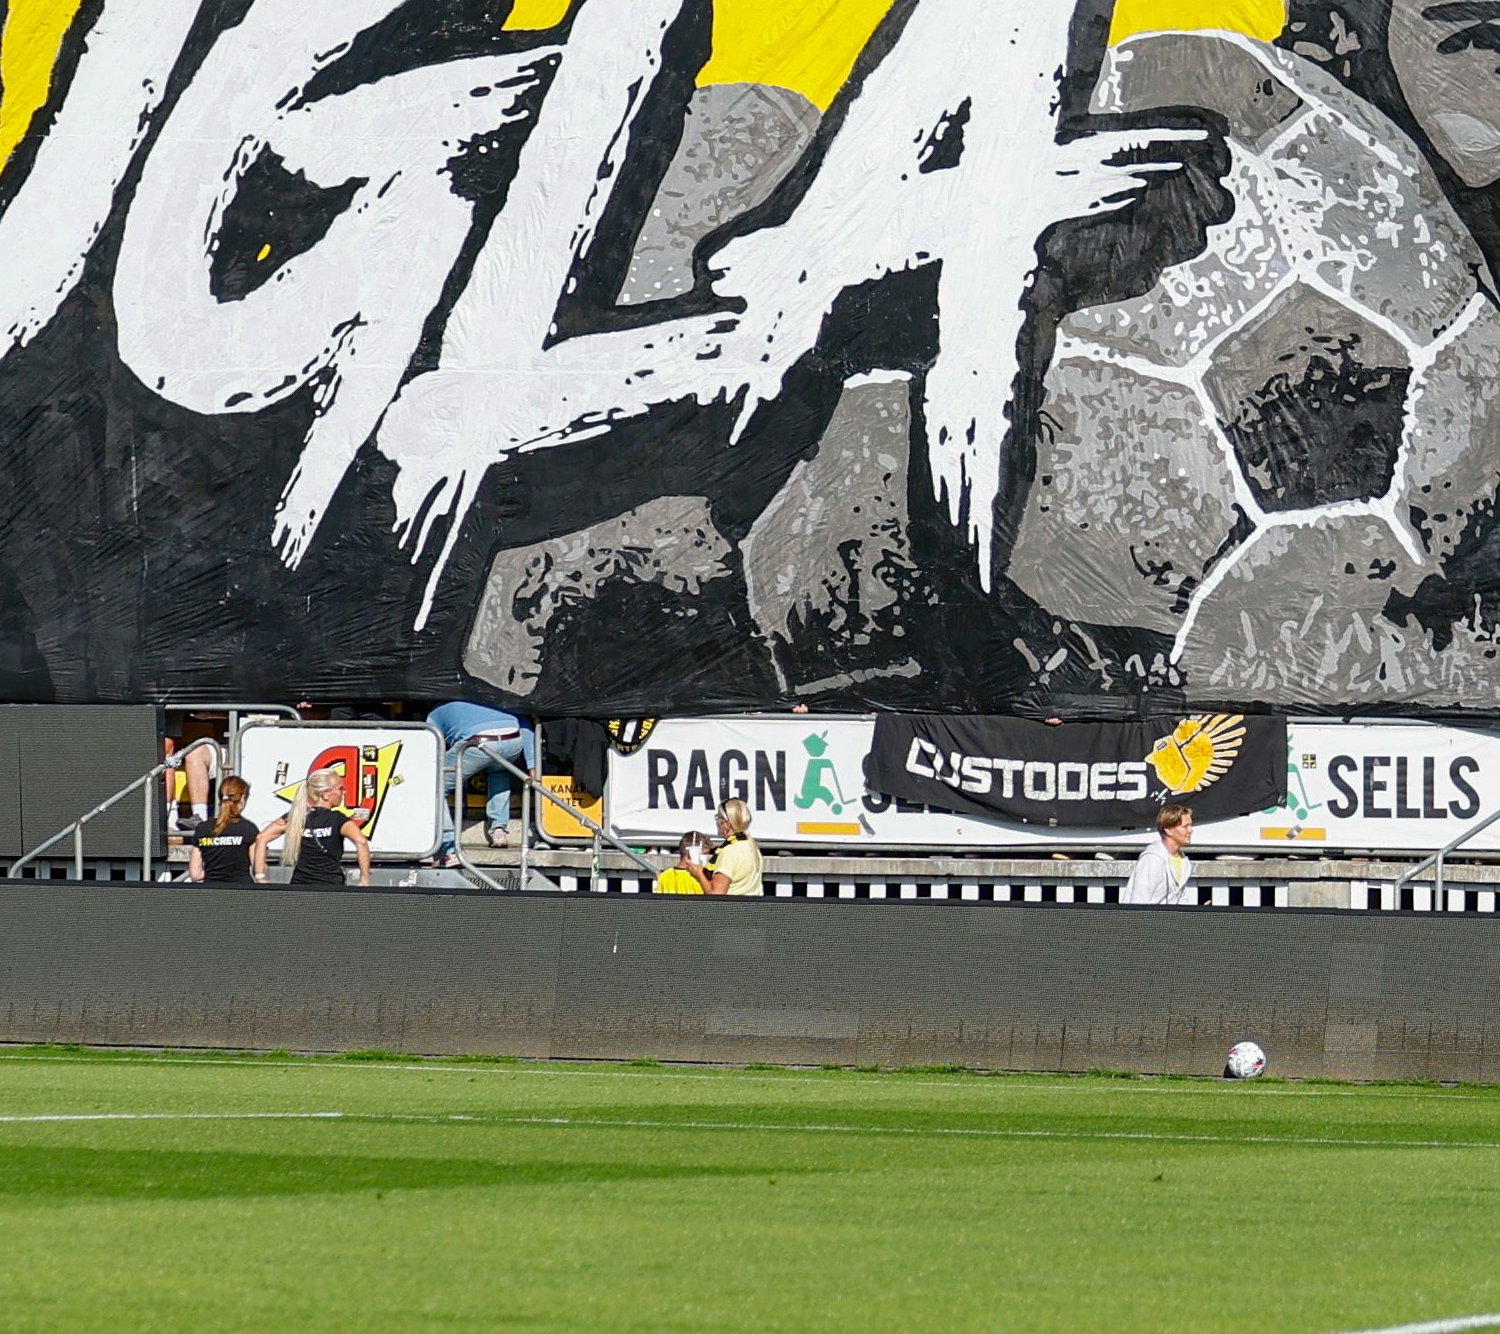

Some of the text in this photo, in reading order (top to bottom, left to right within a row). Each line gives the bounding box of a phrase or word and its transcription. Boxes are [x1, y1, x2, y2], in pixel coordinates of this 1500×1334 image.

[647, 748, 786, 811] RAGN
[905, 737, 1148, 801] CUSTODES
[1327, 755, 1480, 820] SELLS
